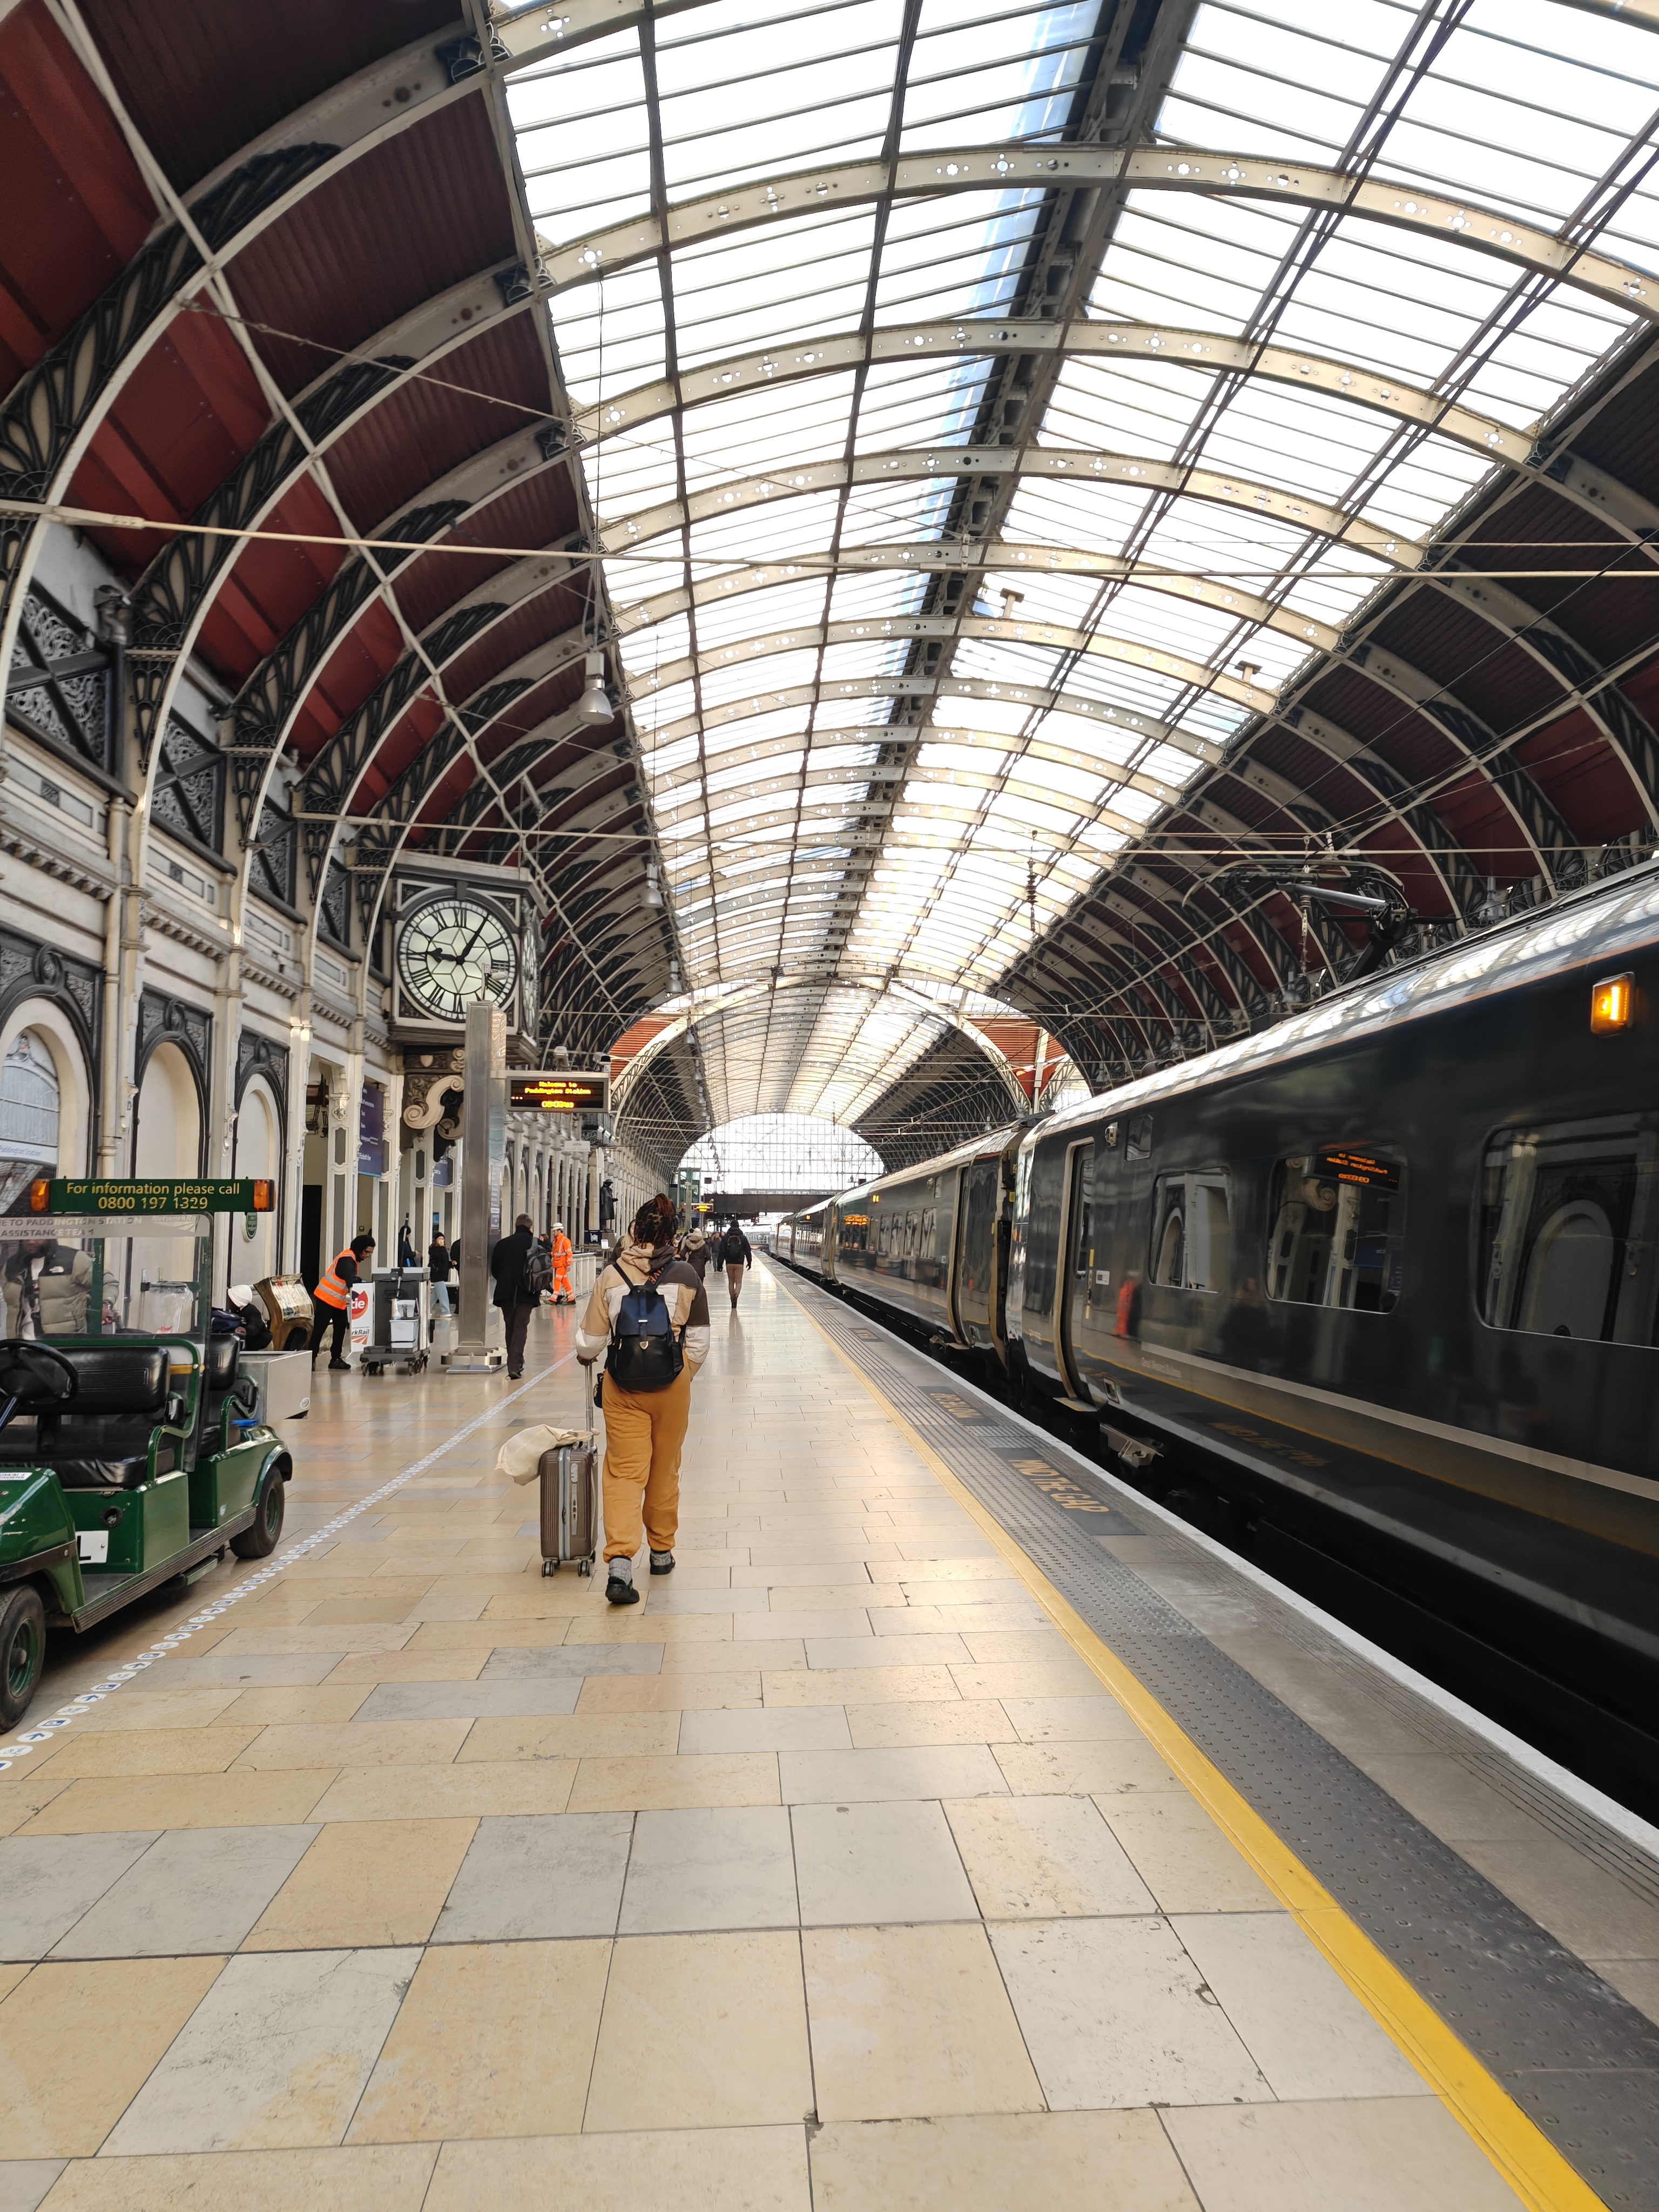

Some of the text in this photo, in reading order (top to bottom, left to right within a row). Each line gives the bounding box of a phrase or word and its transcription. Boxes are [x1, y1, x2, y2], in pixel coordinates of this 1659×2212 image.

[66, 1182, 240, 1197] For information please call
[98, 1197, 208, 1209] 0800 197 1329
[98, 1217, 141, 1225] STATION
[1008, 1460, 1110, 1512] MIND THE GAP
